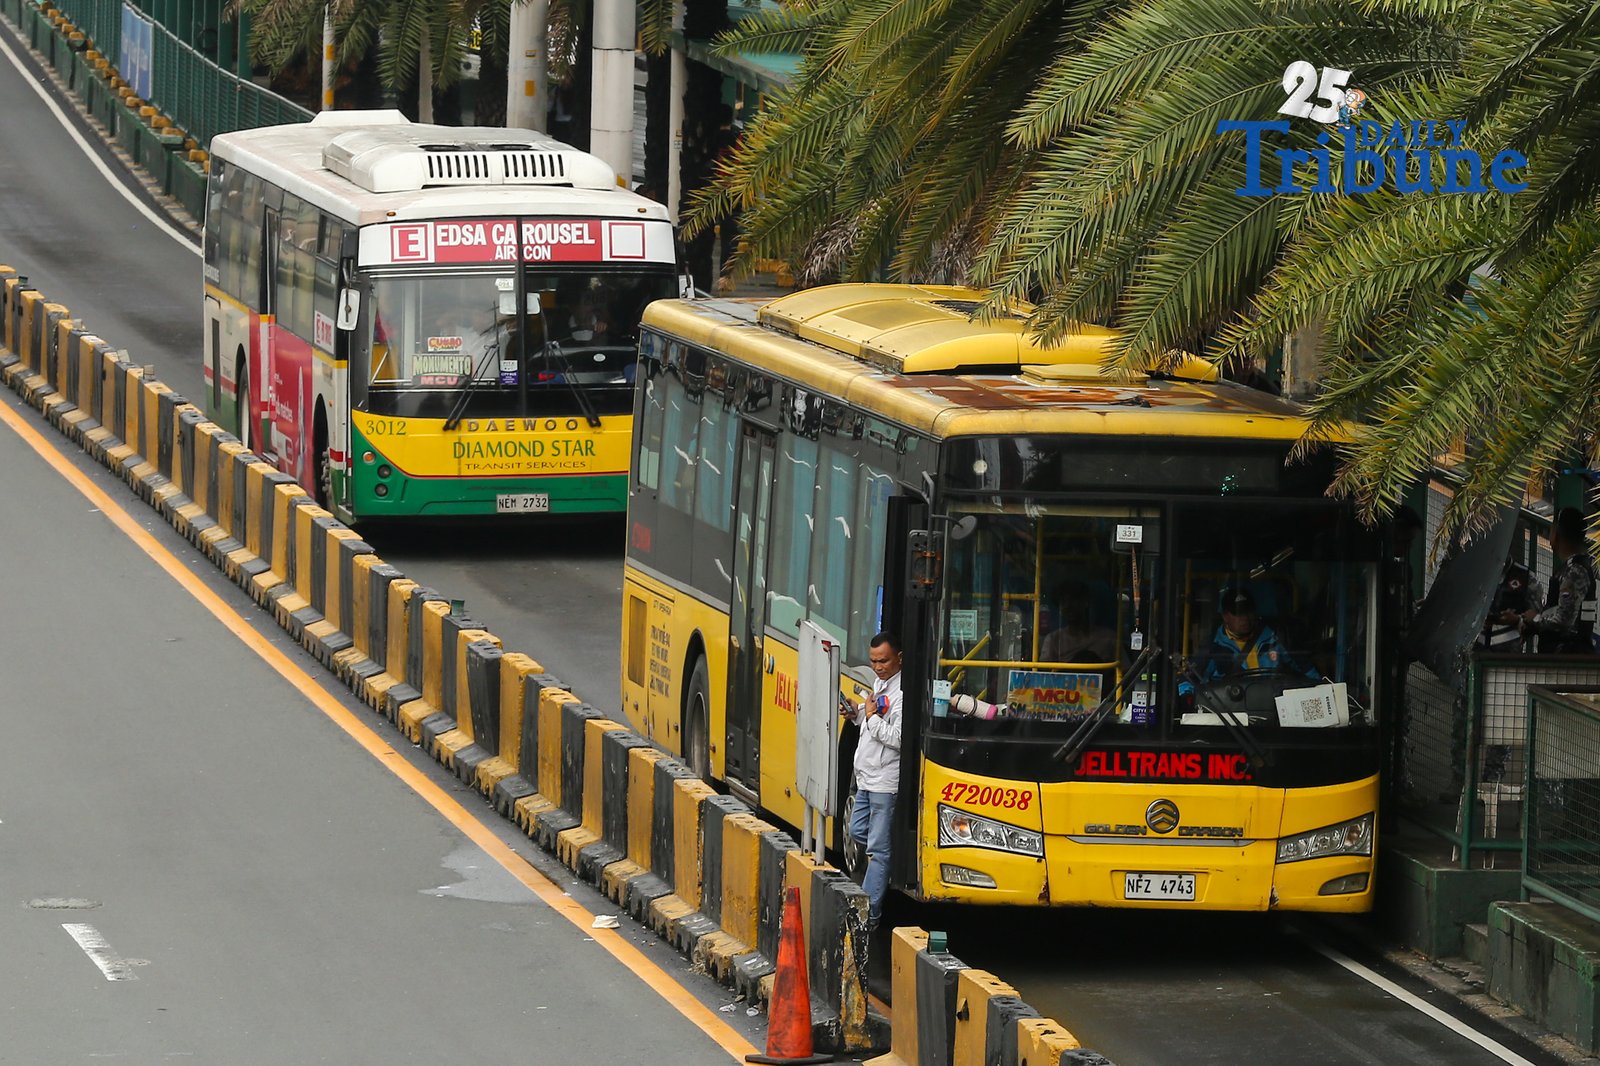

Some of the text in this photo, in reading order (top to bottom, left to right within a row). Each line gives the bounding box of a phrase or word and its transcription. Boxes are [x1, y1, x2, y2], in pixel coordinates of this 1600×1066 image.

[436, 224, 487, 246] EDSA
[365, 420, 407, 436] 3012
[467, 419, 579, 432] DAEWOO
[453, 439, 596, 460] DIAMOND STAR
[464, 461, 587, 471] TRANSIT SERVICES
[498, 497, 548, 509] NEM 2732
[1032, 689, 1081, 705] MCU
[1208, 754, 1254, 780] INC.
[941, 782, 1033, 810] 4720038
[1084, 823, 1244, 837] GOLDEN DRAGON
[1127, 878, 1193, 895] NFZ 4743
